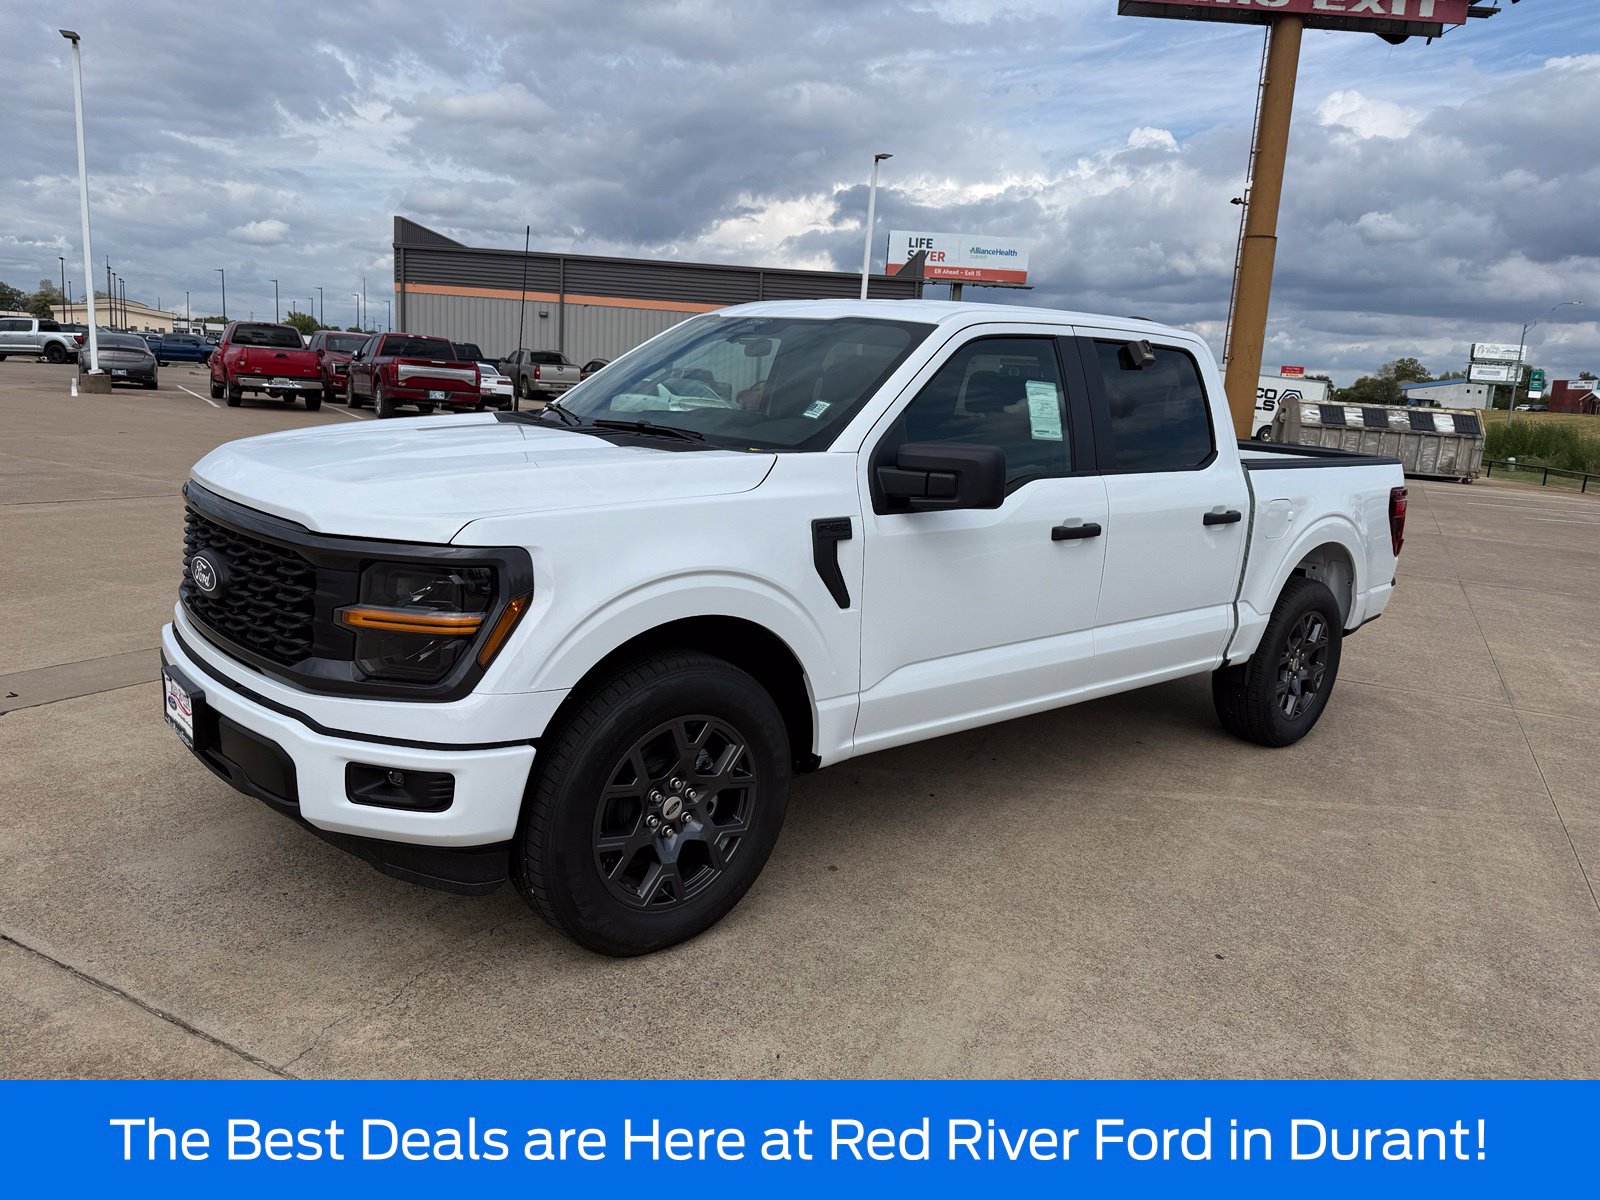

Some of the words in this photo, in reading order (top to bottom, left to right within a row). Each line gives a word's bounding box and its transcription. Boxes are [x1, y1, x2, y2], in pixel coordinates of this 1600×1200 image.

[908, 237, 934, 249] LIFE
[969, 247, 1018, 257] AllianceHealth
[194, 560, 211, 587] Ford
